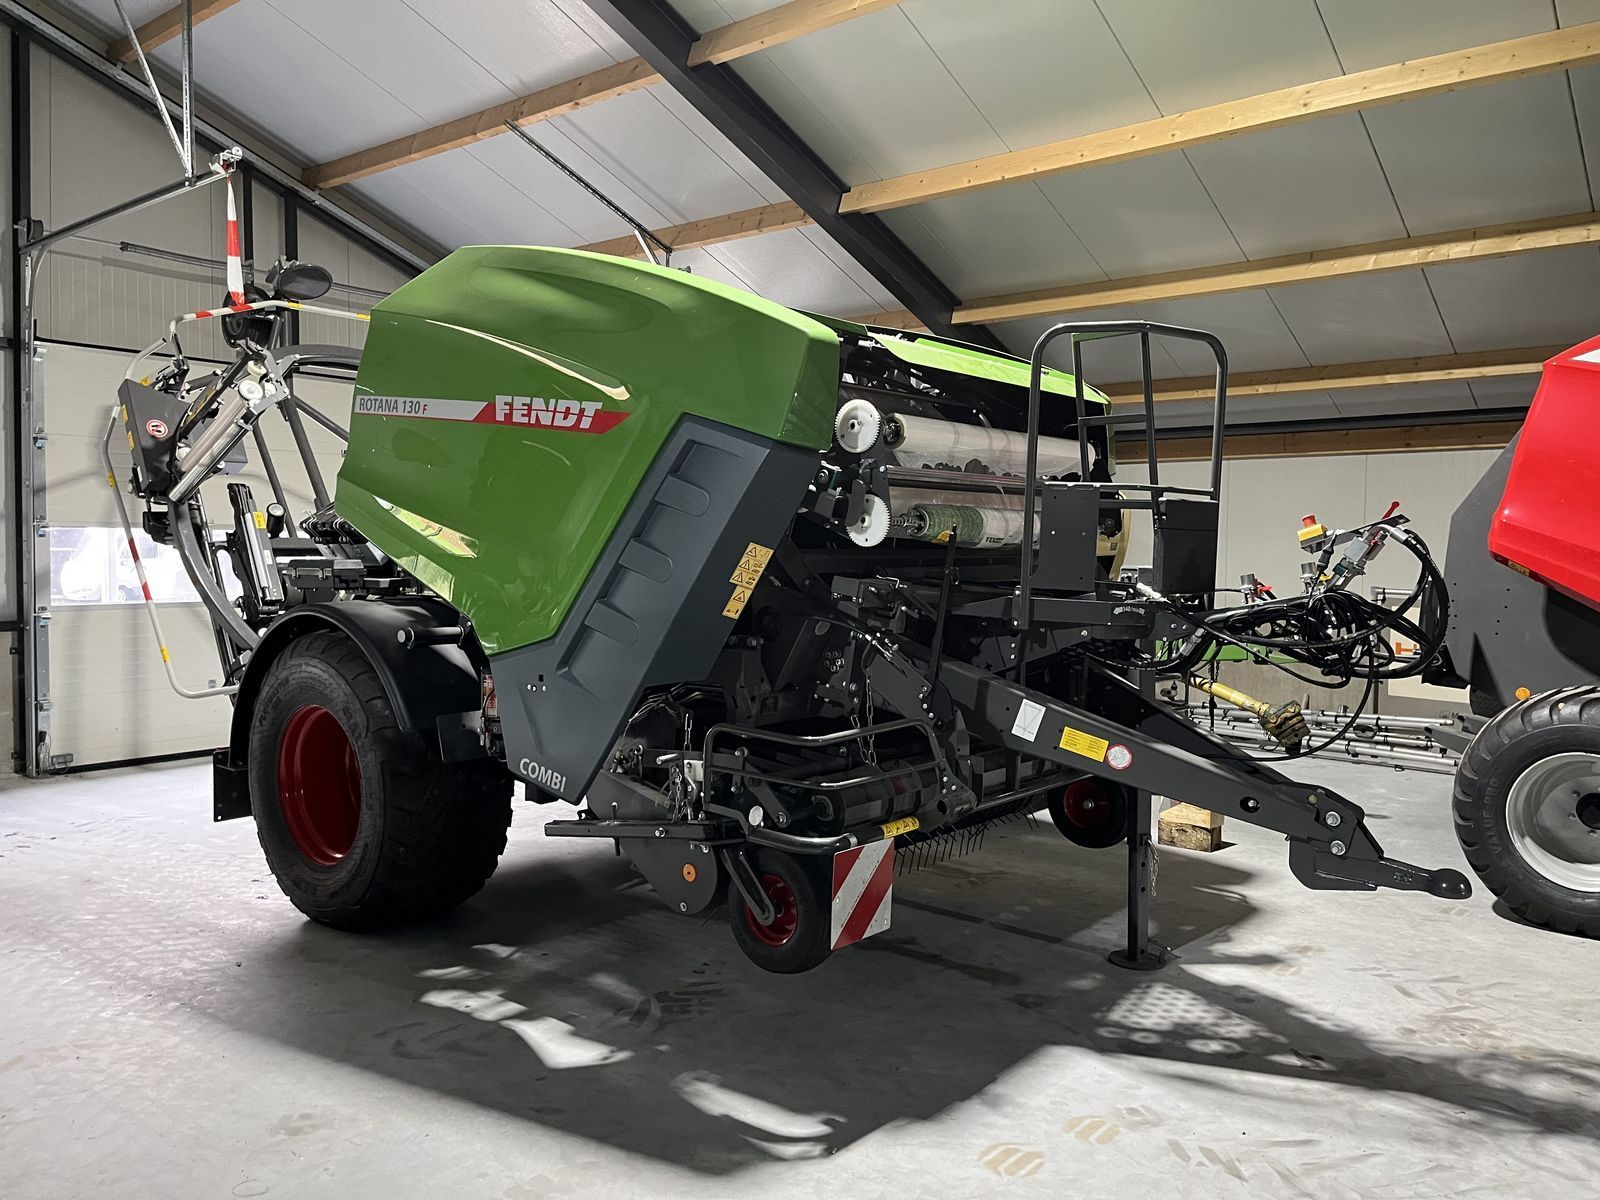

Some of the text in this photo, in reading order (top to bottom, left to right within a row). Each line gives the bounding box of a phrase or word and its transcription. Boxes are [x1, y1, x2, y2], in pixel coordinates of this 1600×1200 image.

[359, 397, 428, 416] ROTANA 130 F
[495, 395, 603, 430] FENDT
[519, 757, 567, 793] COMBI
